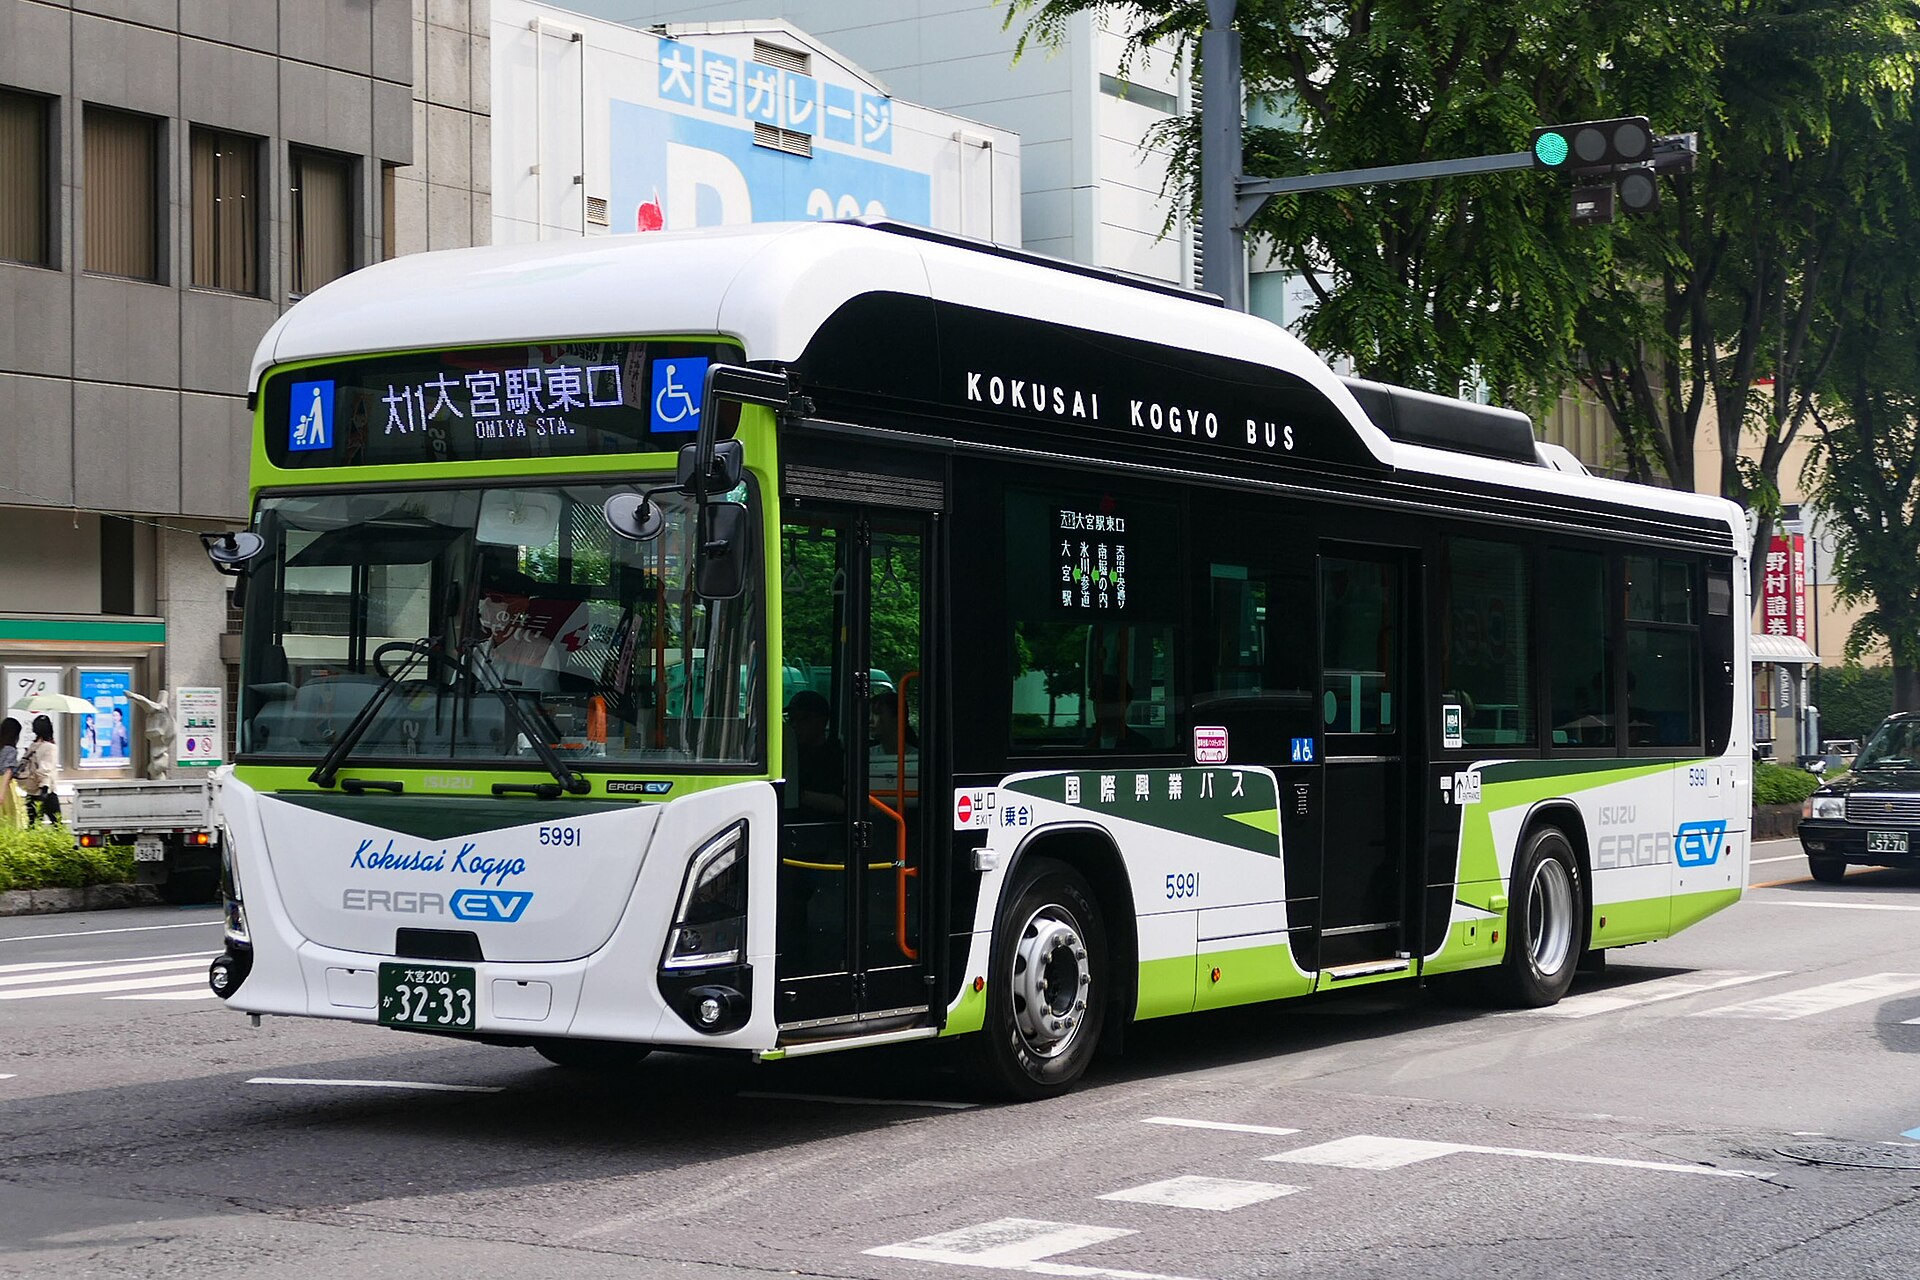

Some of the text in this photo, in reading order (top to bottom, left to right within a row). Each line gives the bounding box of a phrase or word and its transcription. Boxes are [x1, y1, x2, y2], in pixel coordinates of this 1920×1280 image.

[661, 49, 889, 143] 大宮ガレージ
[424, 364, 624, 420] 大宮駅東口
[967, 371, 1294, 451] KOKUSAI KOGYO BUS
[475, 416, 575, 439] OMIYA STA.
[1076, 512, 1125, 532] 大宮駅東口
[1061, 540, 1072, 606] 大宮駅
[424, 776, 475, 790] ISUZU
[608, 782, 670, 793] ERGA EV
[1065, 771, 1244, 804] 国際興業バス
[1689, 768, 1707, 786] 5991
[974, 792, 995, 811] 出口
[976, 814, 992, 826] EXIT
[1000, 805, 1034, 827] (乗合)
[1599, 805, 1636, 826] ISUZU
[539, 827, 581, 847] 5991
[1597, 827, 1720, 869] ERGA EV
[1876, 840, 1906, 851] 57-70
[351, 839, 526, 887] Kokusai Kogyo
[1166, 872, 1200, 899] 5991
[342, 889, 522, 918] ERGA EV
[404, 969, 450, 985] 大宮200
[382, 984, 472, 1026] か 32-33
